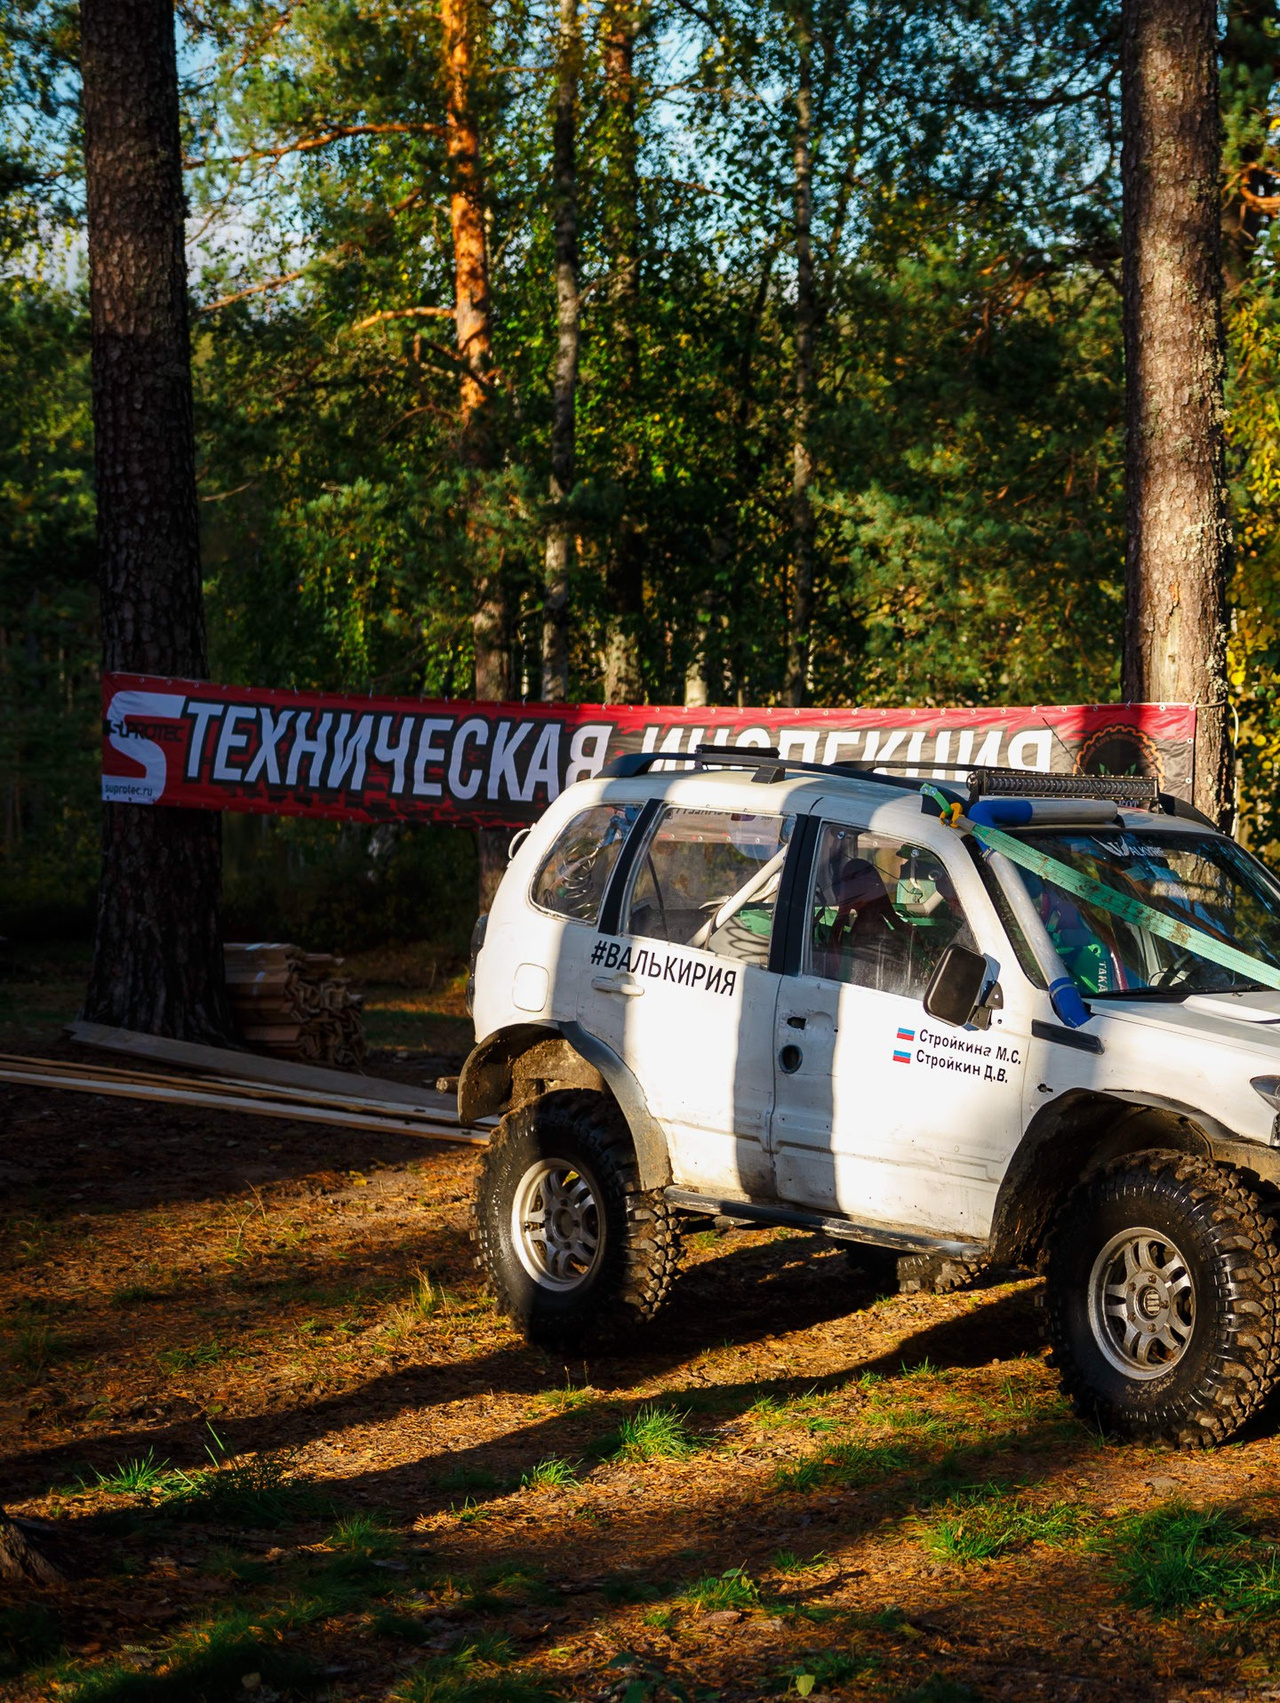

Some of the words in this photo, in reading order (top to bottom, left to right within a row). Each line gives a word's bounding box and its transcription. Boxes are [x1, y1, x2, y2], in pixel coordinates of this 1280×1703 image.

[187, 701, 613, 803] ТЕХНИЧЕСКАЯ
[104, 784, 153, 797] suprotec.ru
[590, 939, 737, 996] #ВАЛЬКИРИЯ
[919, 1029, 992, 1057] Стройкина
[996, 1046, 1022, 1065] М.С.
[916, 1049, 981, 1076] Стройкин
[983, 1064, 1008, 1083] Д.В.
